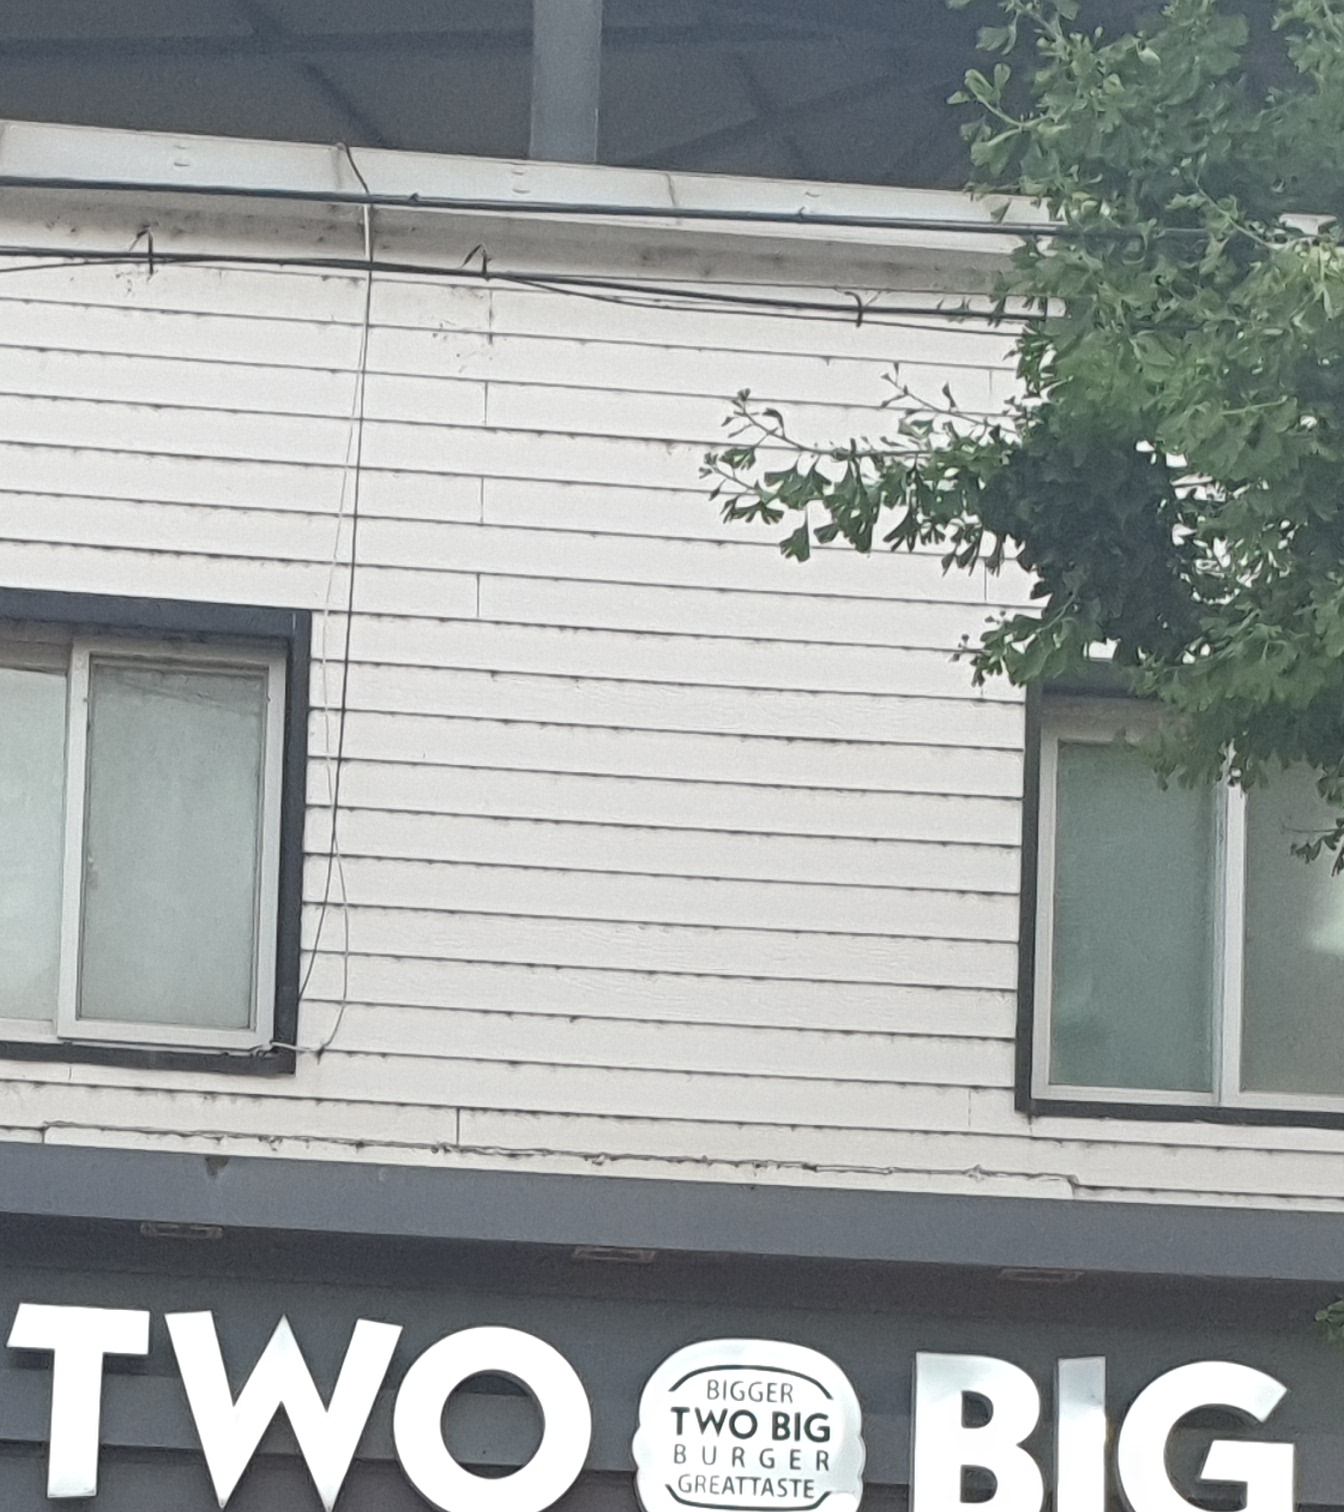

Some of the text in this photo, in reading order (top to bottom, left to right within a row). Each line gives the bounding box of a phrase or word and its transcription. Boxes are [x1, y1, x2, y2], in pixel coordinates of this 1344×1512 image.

[706, 1379, 794, 1404] BIGGER
[670, 1406, 832, 1443] TWO BIG
[673, 1443, 830, 1473] BURGER
[677, 1473, 815, 1499] GREATTASTE
